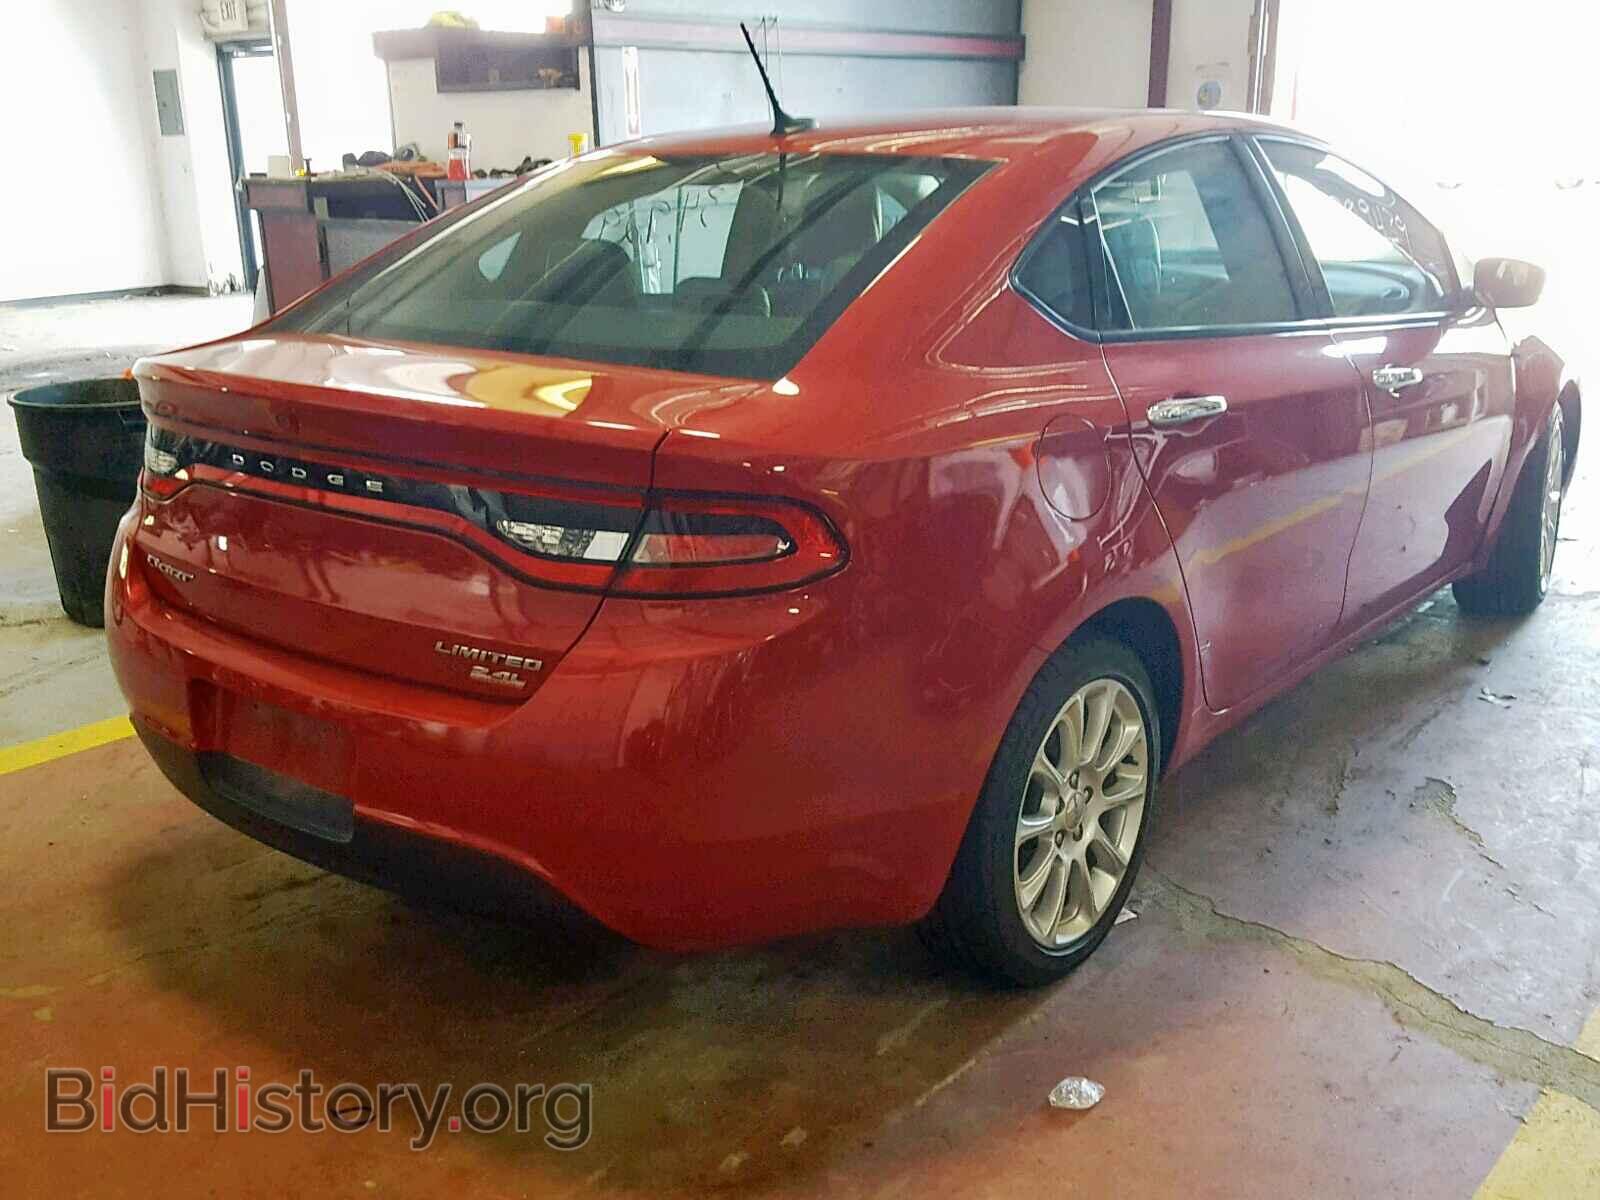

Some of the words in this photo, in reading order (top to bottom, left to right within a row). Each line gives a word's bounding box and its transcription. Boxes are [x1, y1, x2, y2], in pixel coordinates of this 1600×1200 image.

[231, 453, 384, 493] DODGE
[435, 641, 542, 671] LIMITED
[469, 665, 526, 688] 2.4L
